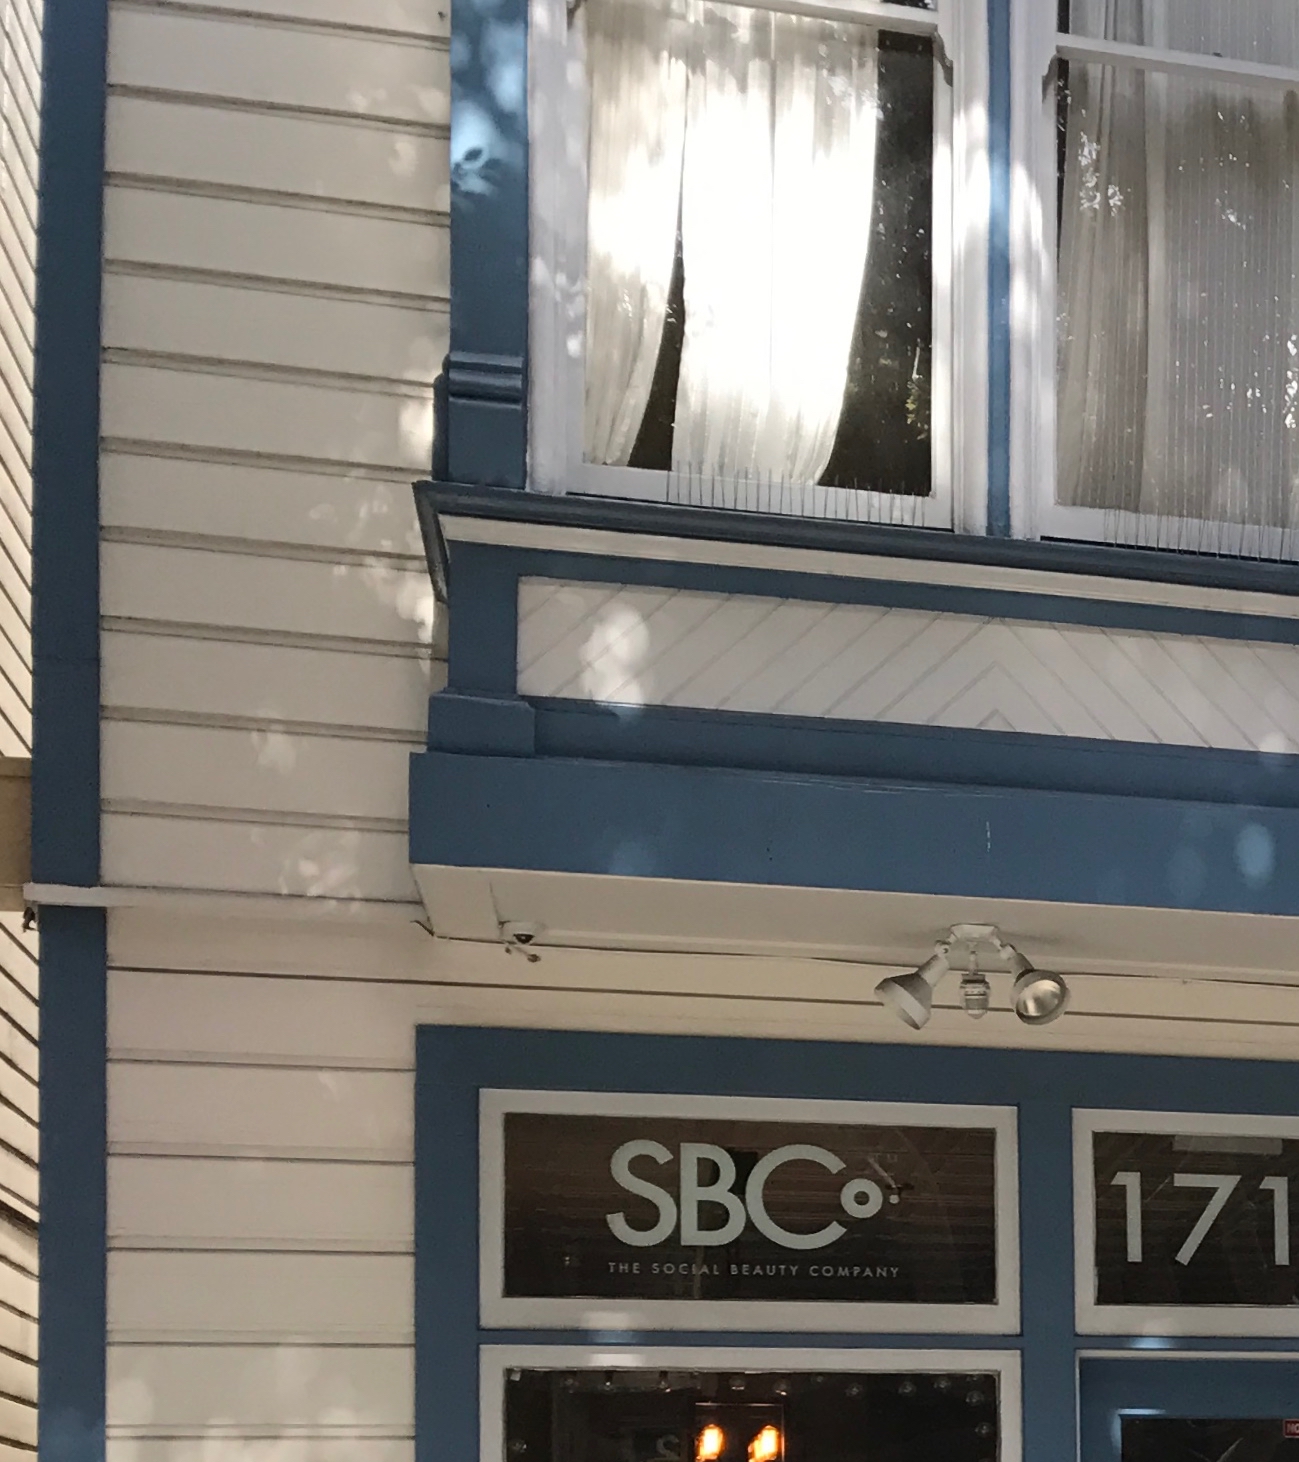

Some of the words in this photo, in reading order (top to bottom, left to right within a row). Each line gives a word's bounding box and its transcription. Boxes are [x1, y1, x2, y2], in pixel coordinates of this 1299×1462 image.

[608, 1262, 641, 1275] THE
[651, 1262, 720, 1276] SOCIAL
[730, 1263, 799, 1276] BEAUTY
[809, 1265, 900, 1278] COMPANY
